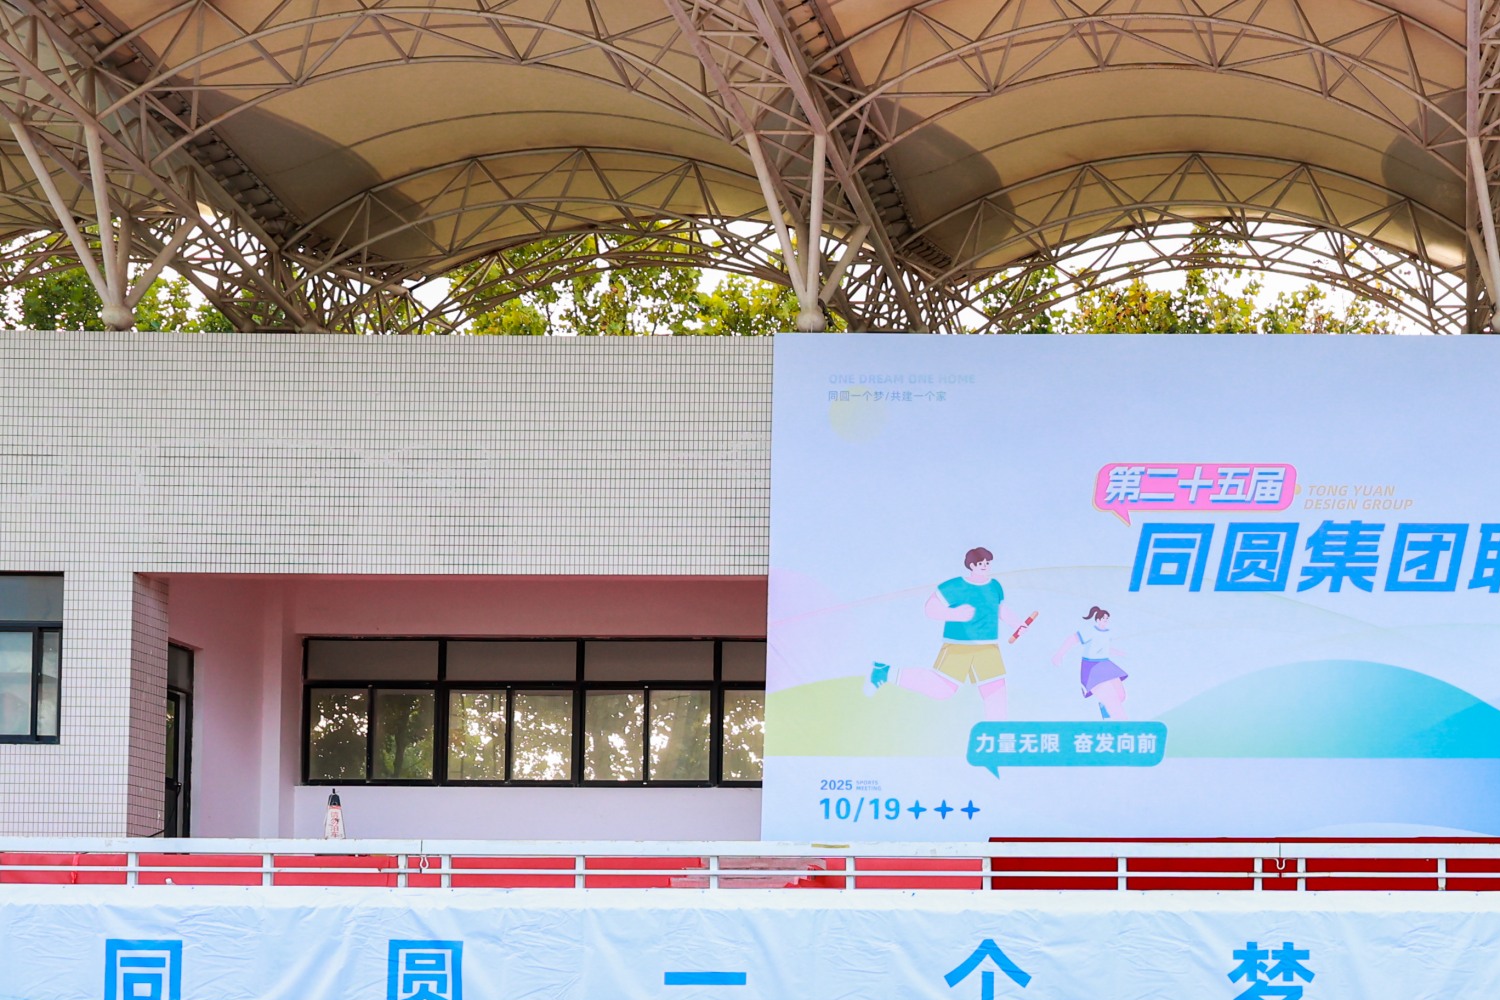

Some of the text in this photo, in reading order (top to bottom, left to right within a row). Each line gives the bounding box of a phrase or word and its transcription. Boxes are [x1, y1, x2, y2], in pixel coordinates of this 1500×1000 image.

[828, 374, 976, 385] ONE DREAM ONE HOME
[1104, 466, 1286, 503] 第二十五届
[1308, 485, 1395, 496] TONG YUAN
[1304, 499, 1413, 510] DESIGN GROUP
[975, 733, 1157, 753] 力量无限 奋发向前
[820, 779, 852, 790] 2025
[819, 797, 900, 822] 10/19
